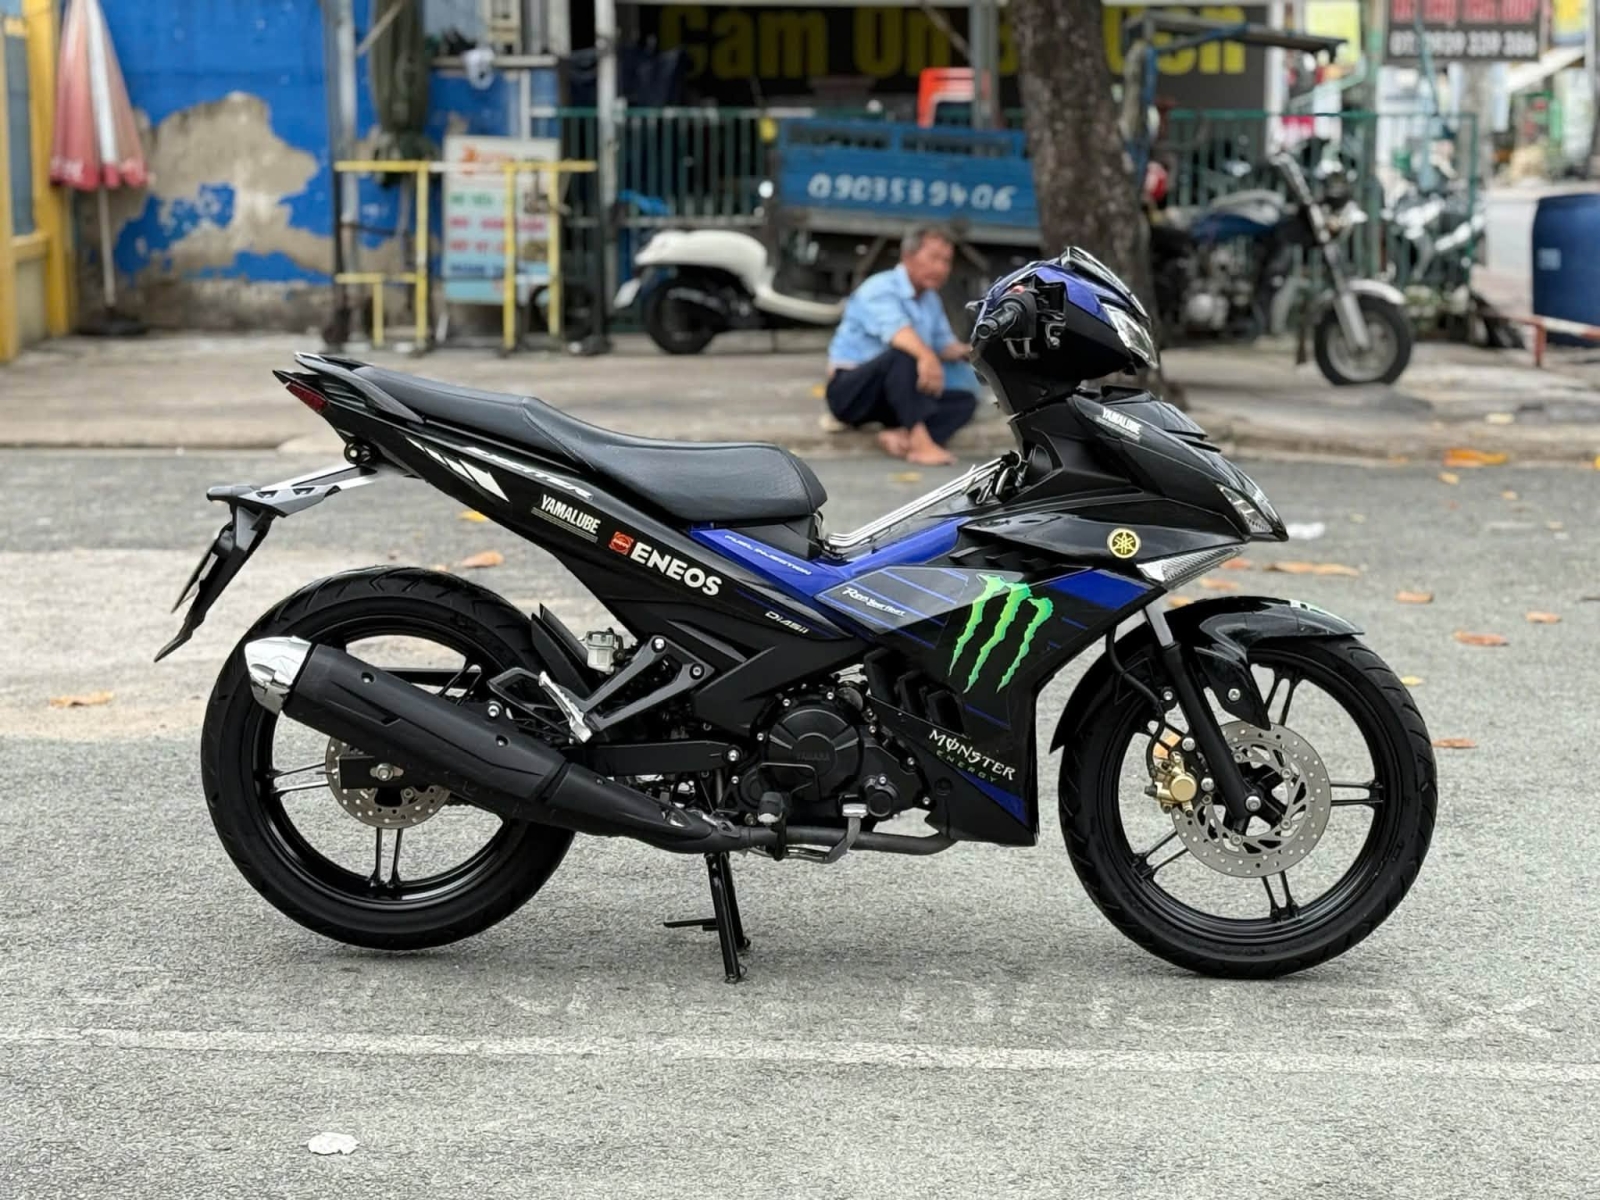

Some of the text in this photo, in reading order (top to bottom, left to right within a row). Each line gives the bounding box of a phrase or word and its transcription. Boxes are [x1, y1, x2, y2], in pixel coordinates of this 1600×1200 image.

[540, 494, 601, 534] YAMALUBE
[630, 541, 722, 596] ENEOS
[936, 750, 998, 783] ENERGY
